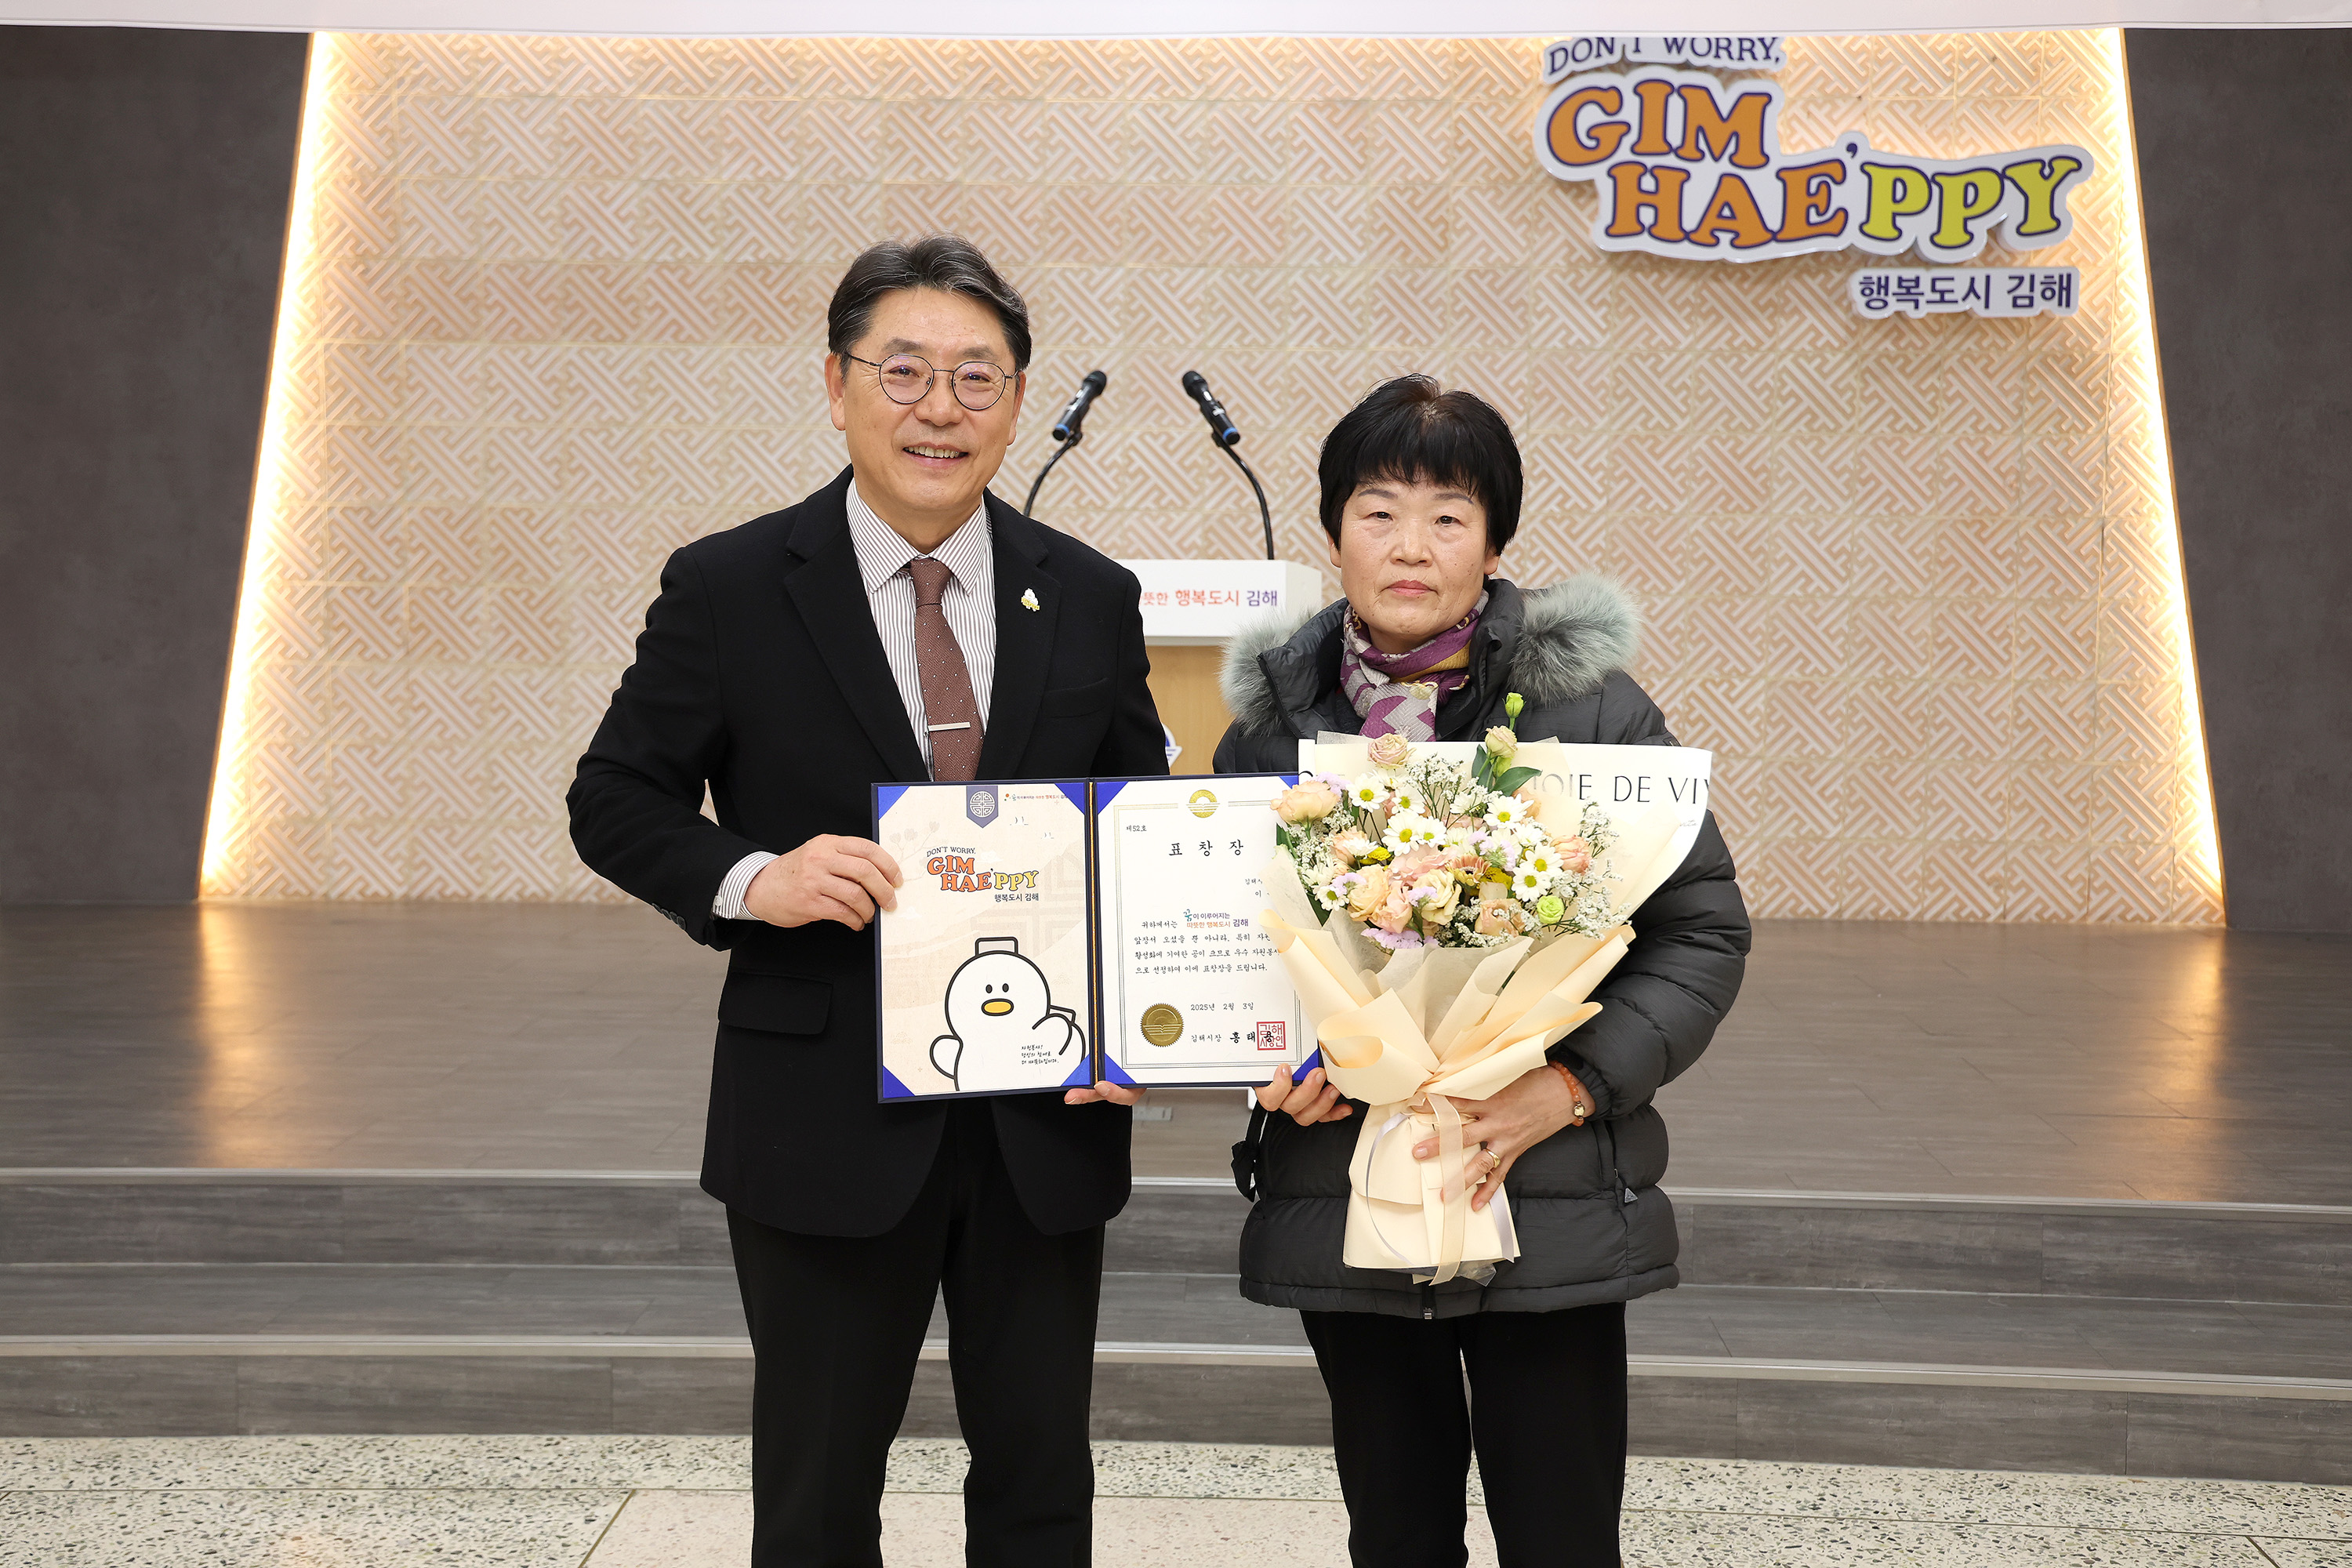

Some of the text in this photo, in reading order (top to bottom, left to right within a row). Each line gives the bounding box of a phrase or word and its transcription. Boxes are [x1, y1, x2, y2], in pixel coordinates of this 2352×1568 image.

[1663, 37, 1780, 64] WORRY,
[1547, 79, 1773, 169] GIM
[1859, 273, 2072, 310] 행복도시 김해
[1139, 589, 1278, 607] 뜻한 행복도시 김해
[1613, 775, 1650, 803] DE
[926, 846, 949, 858] DON'T
[927, 855, 975, 876] GIM
[995, 894, 1022, 902] 행복도시
[1183, 909, 1199, 922] 꿈이
[1134, 936, 1156, 945] 앞장서
[1135, 951, 1162, 960] 활성화에
[1192, 949, 1204, 958] 공이
[1192, 1034, 1221, 1043] 김해시장
